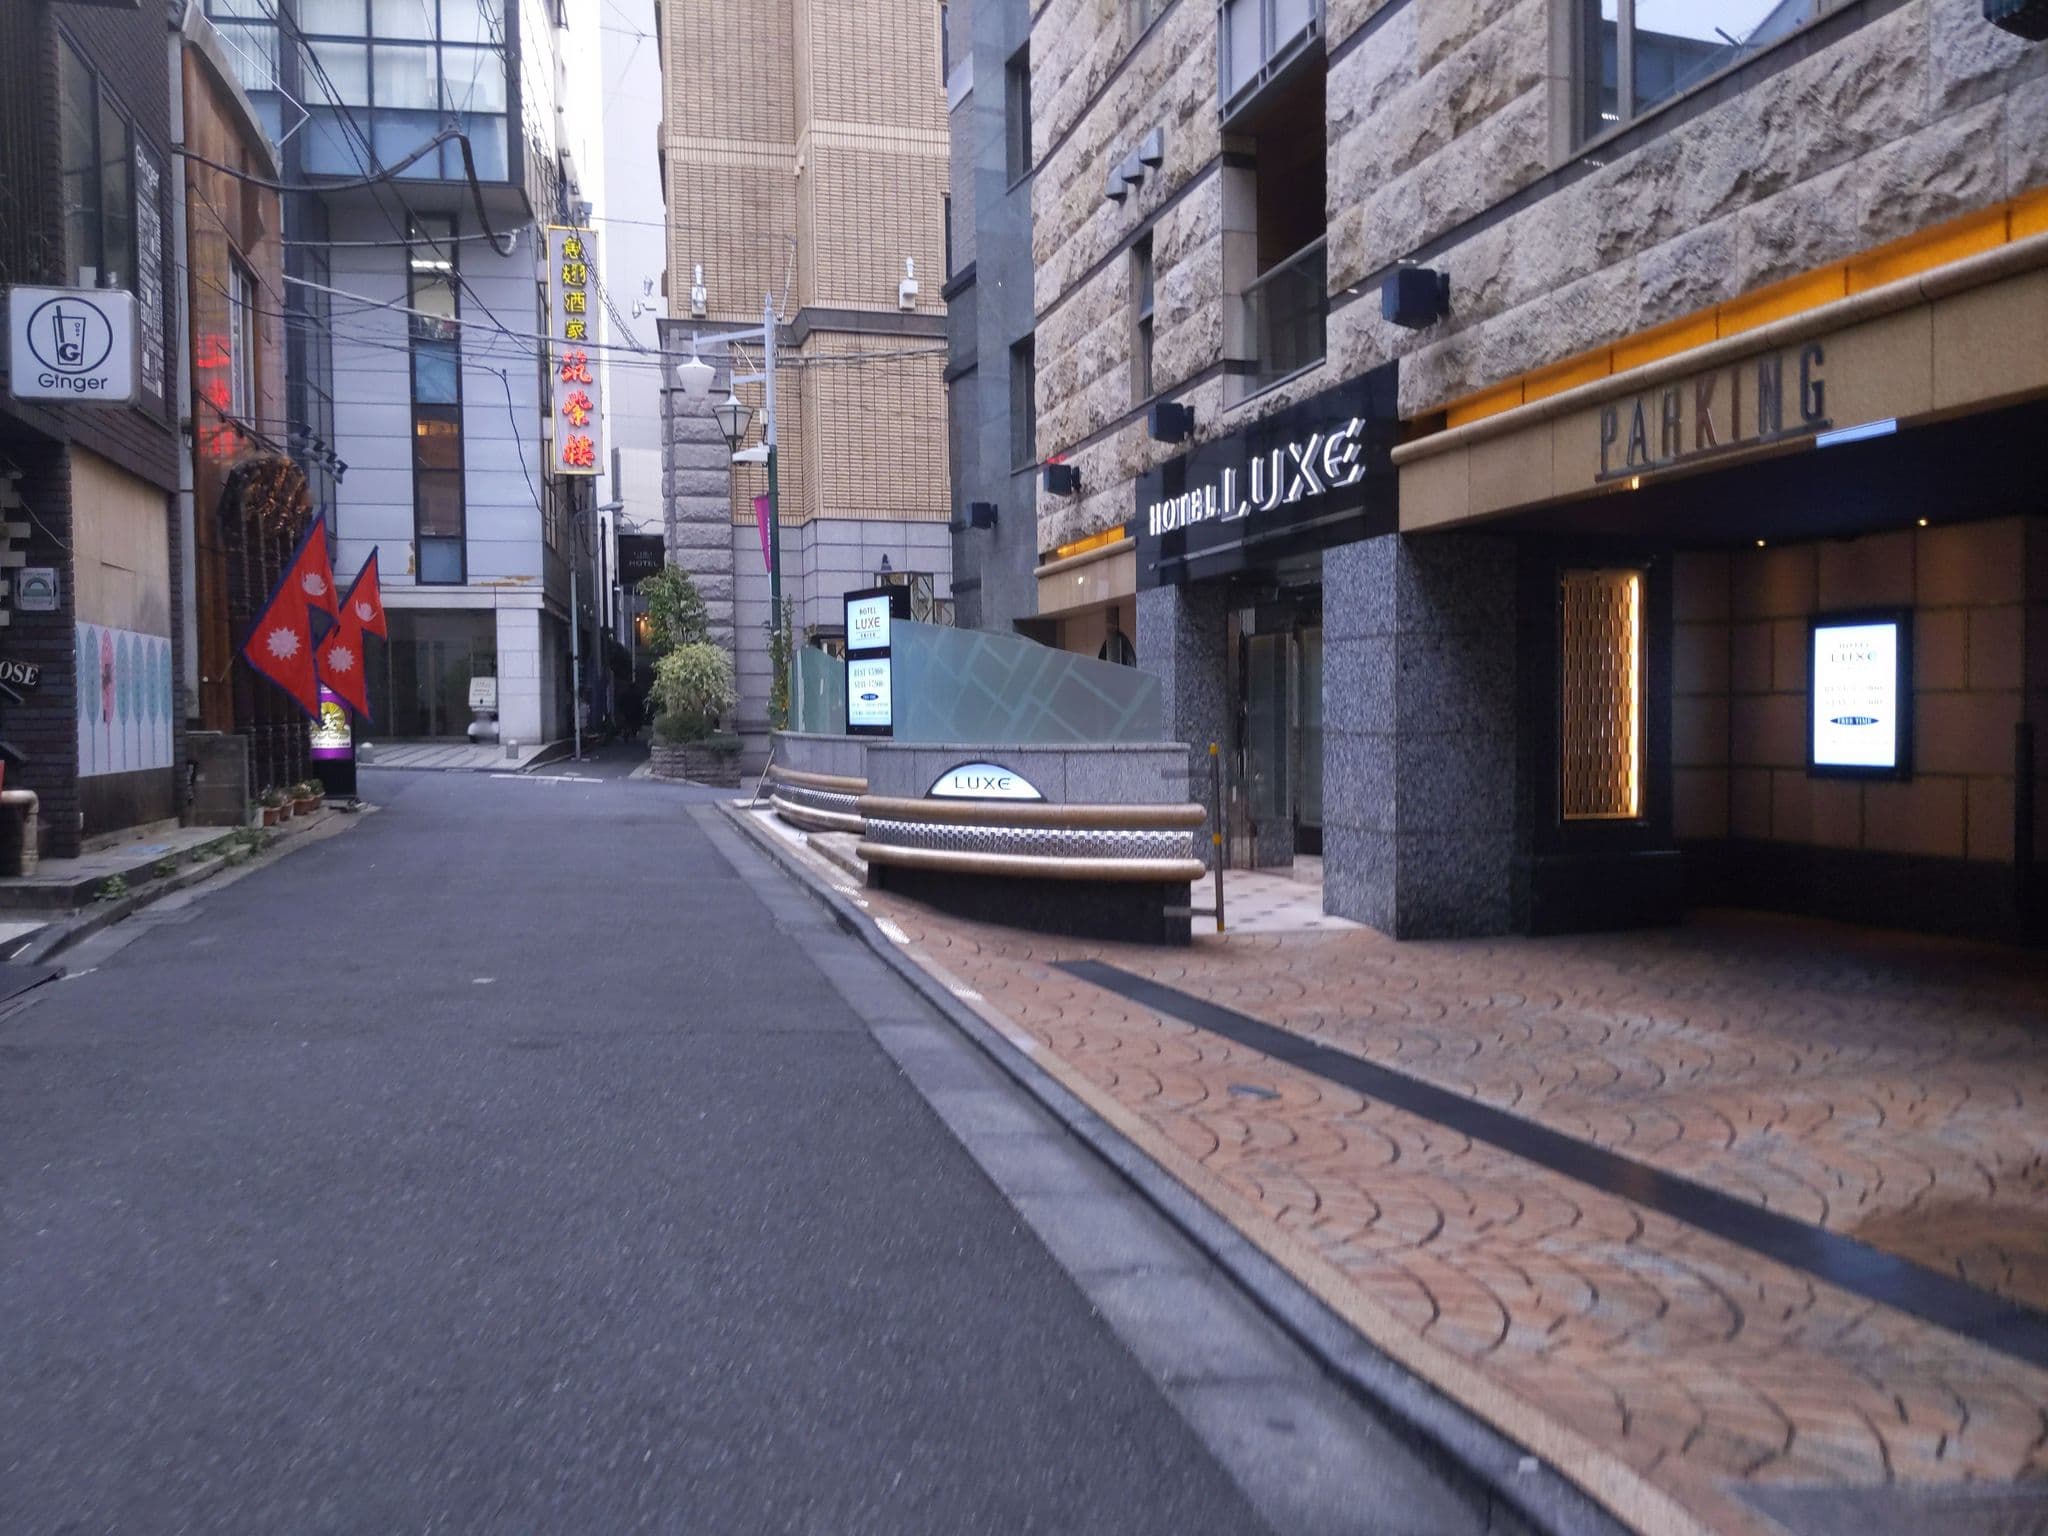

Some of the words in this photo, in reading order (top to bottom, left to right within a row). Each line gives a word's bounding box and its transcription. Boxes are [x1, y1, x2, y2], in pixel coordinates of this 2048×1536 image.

[38, 373, 108, 393] Ginger
[1600, 343, 1826, 475] PARKING
[1150, 484, 1222, 536] HOTEL
[1221, 417, 1366, 523] LUXE
[855, 616, 881, 630] LUXE
[954, 776, 1012, 791] LUXE
